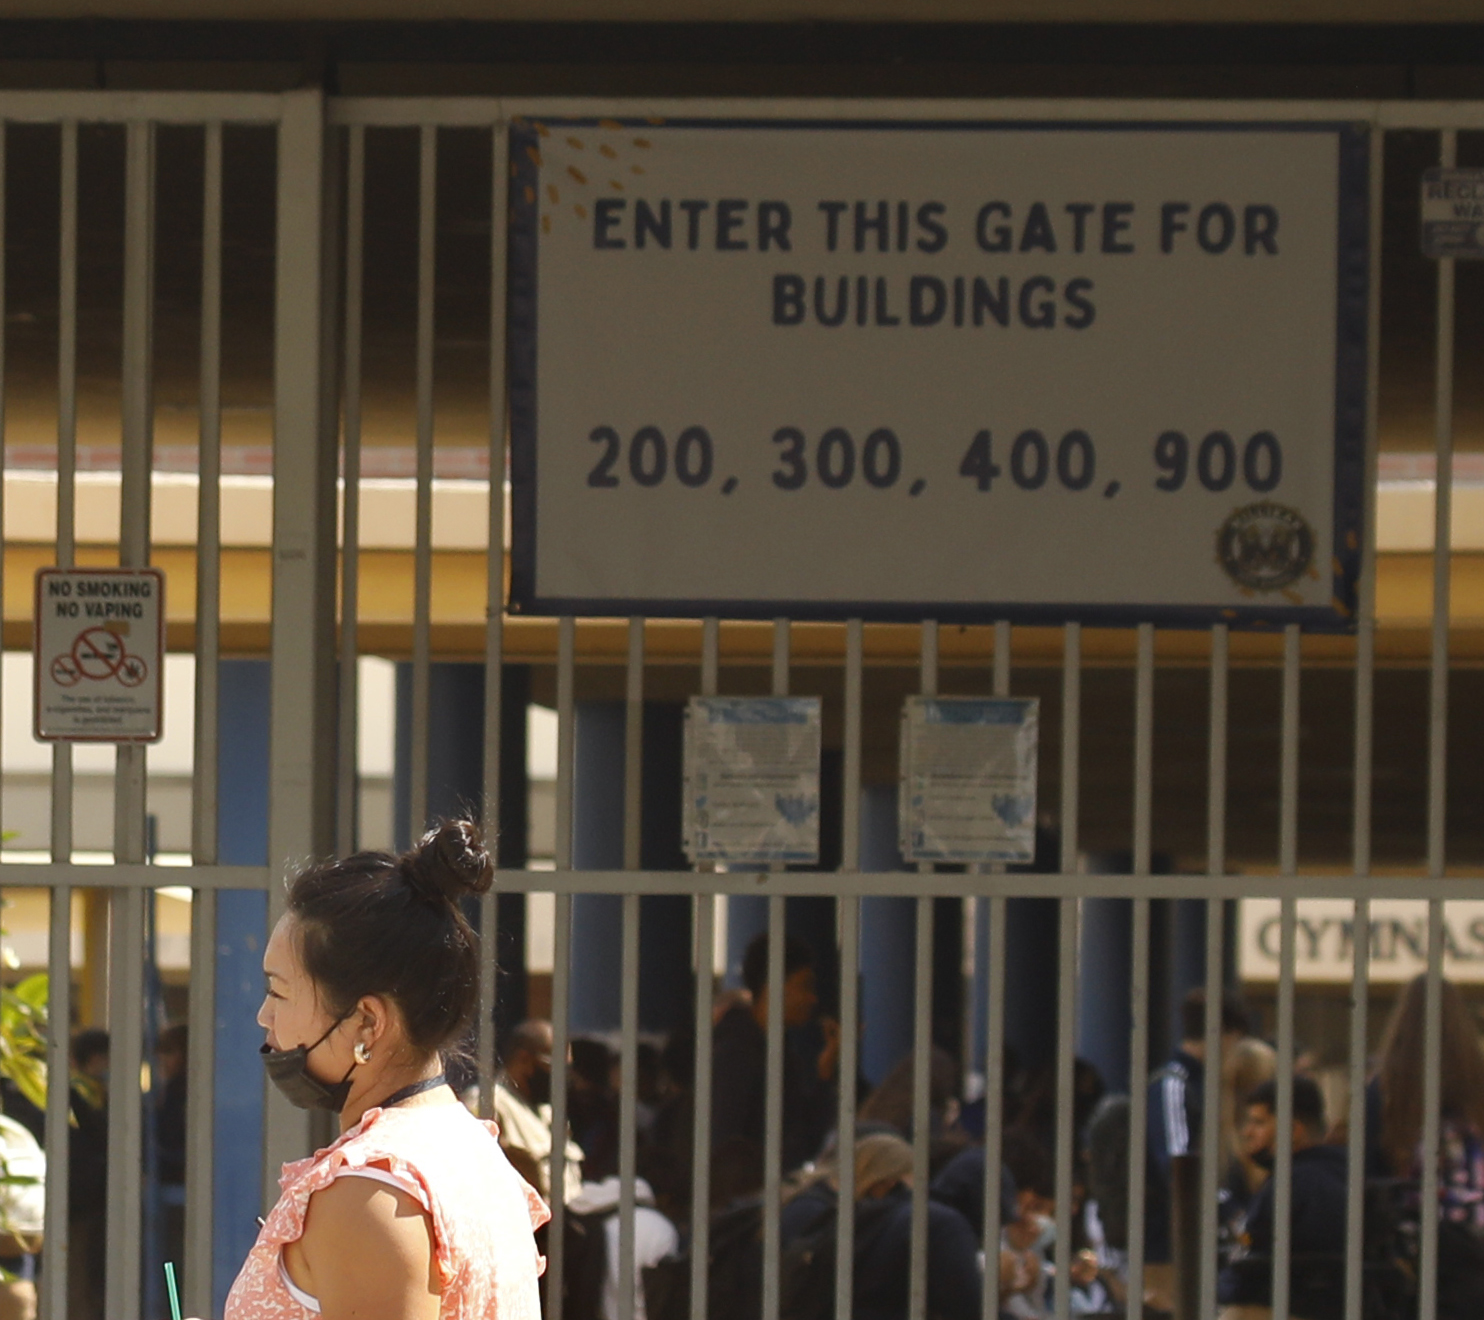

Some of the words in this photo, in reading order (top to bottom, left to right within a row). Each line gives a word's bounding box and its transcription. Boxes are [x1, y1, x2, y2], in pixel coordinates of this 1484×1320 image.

[592, 197, 793, 253] ENTER
[817, 199, 949, 255] THIS
[974, 200, 1136, 255] GATE
[1159, 201, 1280, 257] FOR
[771, 273, 1097, 331] BUILDINGS
[587, 425, 738, 497] 200,
[771, 426, 926, 497] 300,
[958, 428, 1121, 499] 400,
[1153, 429, 1283, 494] 900
[48, 581, 72, 597] NO
[77, 581, 151, 598] SMOKING
[56, 601, 80, 617] NO
[85, 601, 143, 618] VAPING
